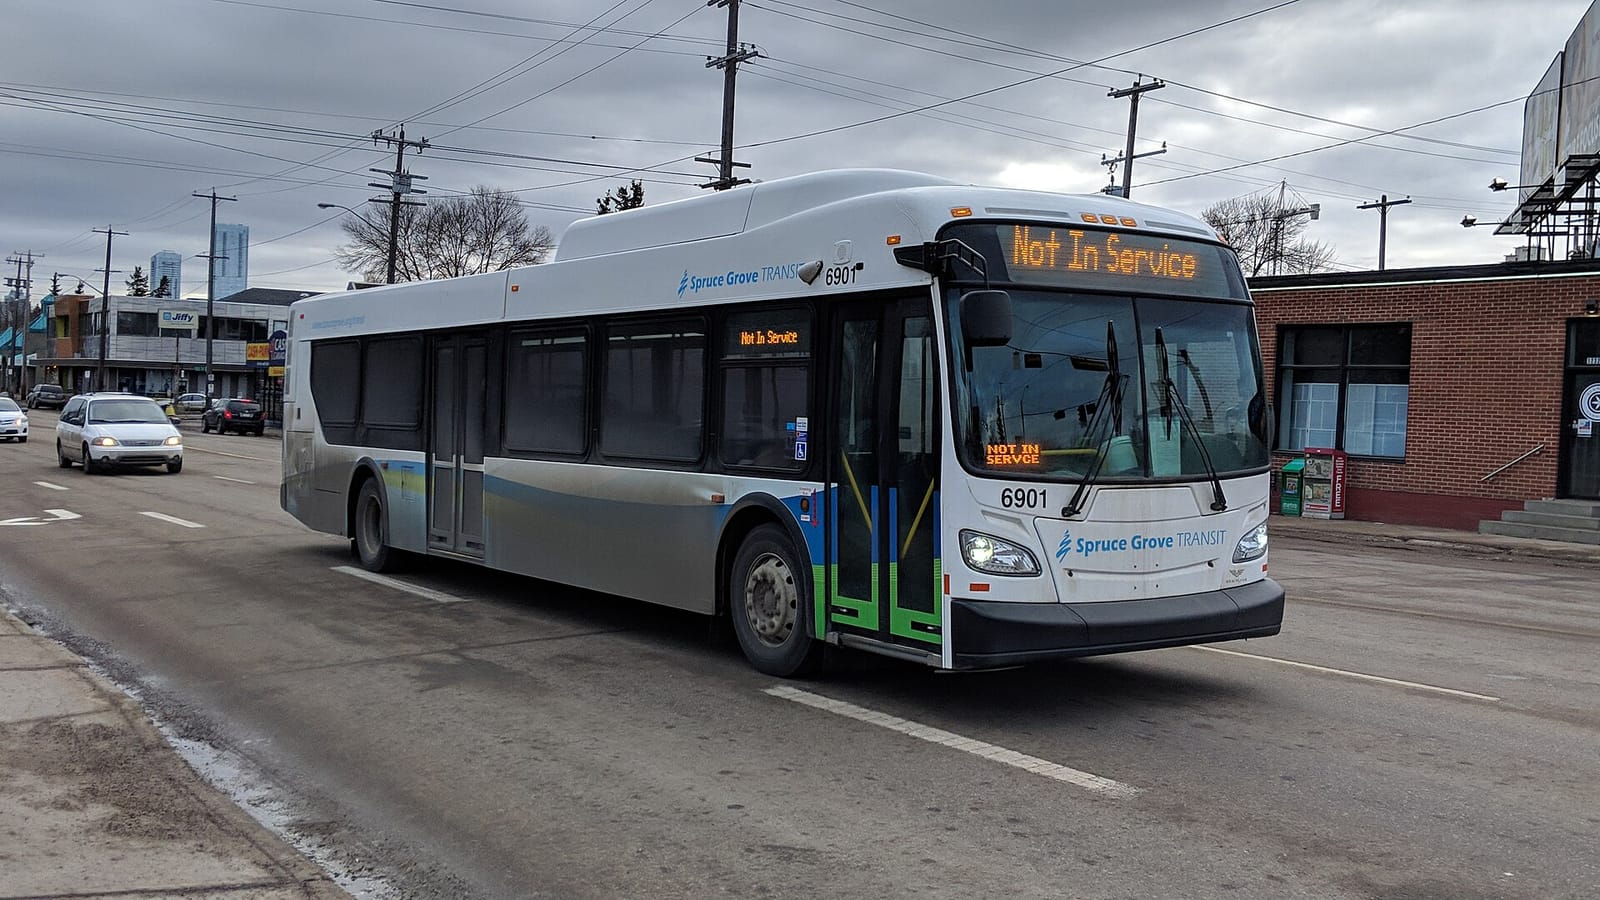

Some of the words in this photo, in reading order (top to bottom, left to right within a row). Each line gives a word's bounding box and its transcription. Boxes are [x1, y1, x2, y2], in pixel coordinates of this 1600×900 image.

[1014, 225, 1060, 267] Not
[1068, 230, 1098, 270] In
[1106, 233, 1196, 278] Service
[690, 275, 724, 293] Spruce
[726, 271, 759, 286] Grove
[825, 265, 857, 286] 6901
[172, 313, 193, 322] Jiffy
[741, 331, 754, 345] Not
[756, 330, 765, 344] In
[767, 329, 798, 344] Service
[986, 454, 1040, 465] SERVCE
[987, 444, 1017, 454] NOT
[1021, 444, 1040, 454] IN
[1001, 487, 1047, 509] 6901
[1076, 537, 1128, 558] Spruce
[1131, 534, 1174, 550] Grove
[1177, 529, 1227, 548] TRANSIT
